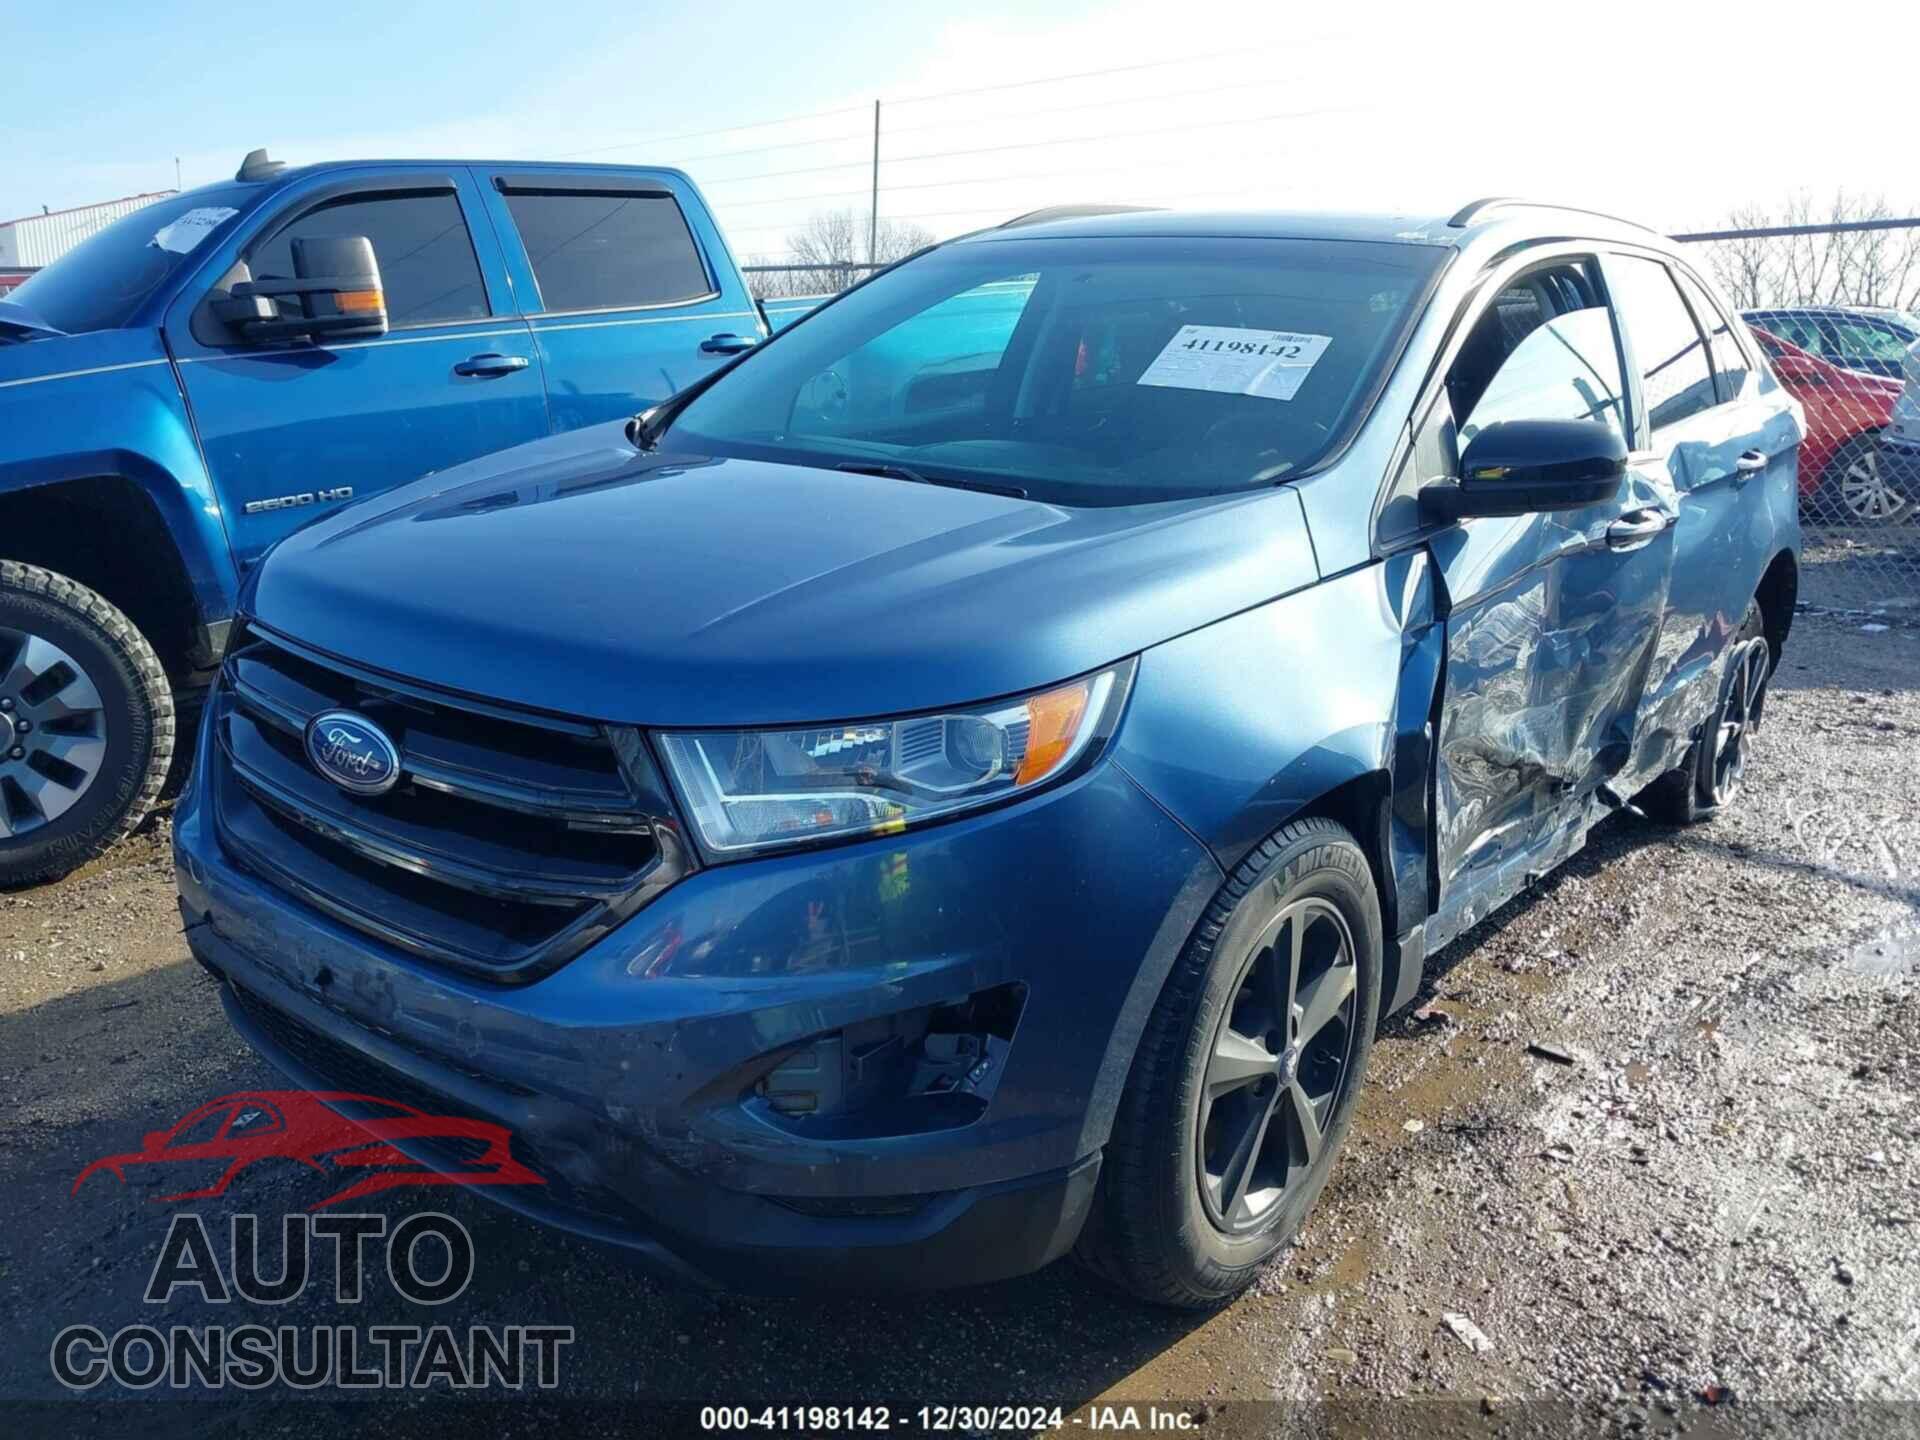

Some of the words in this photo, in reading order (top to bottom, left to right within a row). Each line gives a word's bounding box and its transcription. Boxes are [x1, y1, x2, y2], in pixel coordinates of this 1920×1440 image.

[1182, 338, 1302, 359] 41198142
[245, 492, 315, 514] 2500
[321, 727, 381, 776] Ford
[1296, 844, 1371, 892] MICHELIN
